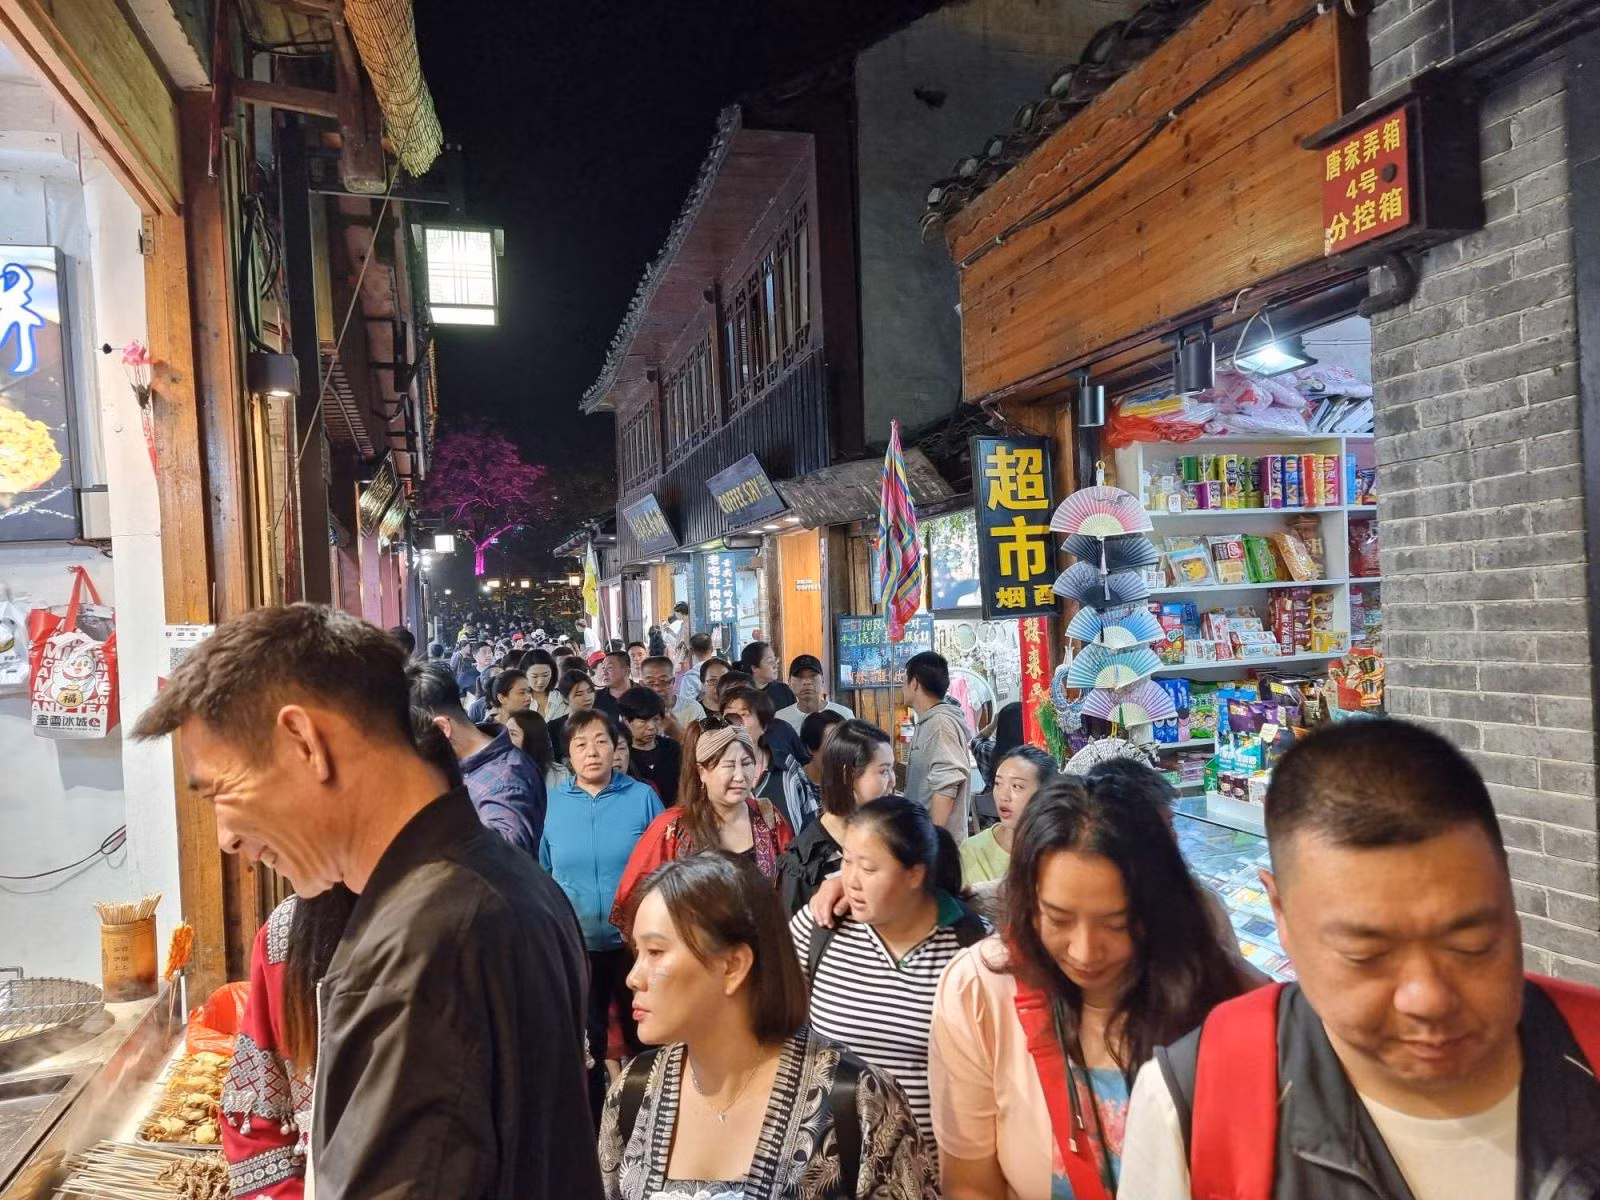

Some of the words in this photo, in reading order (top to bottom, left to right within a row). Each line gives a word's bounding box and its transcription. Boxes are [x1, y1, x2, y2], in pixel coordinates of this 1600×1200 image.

[1325, 119, 1400, 181] 唐家弄箱
[1346, 168, 1378, 199] 4号
[1329, 187, 1402, 244] 分控箱
[985, 445, 1050, 582] 超市
